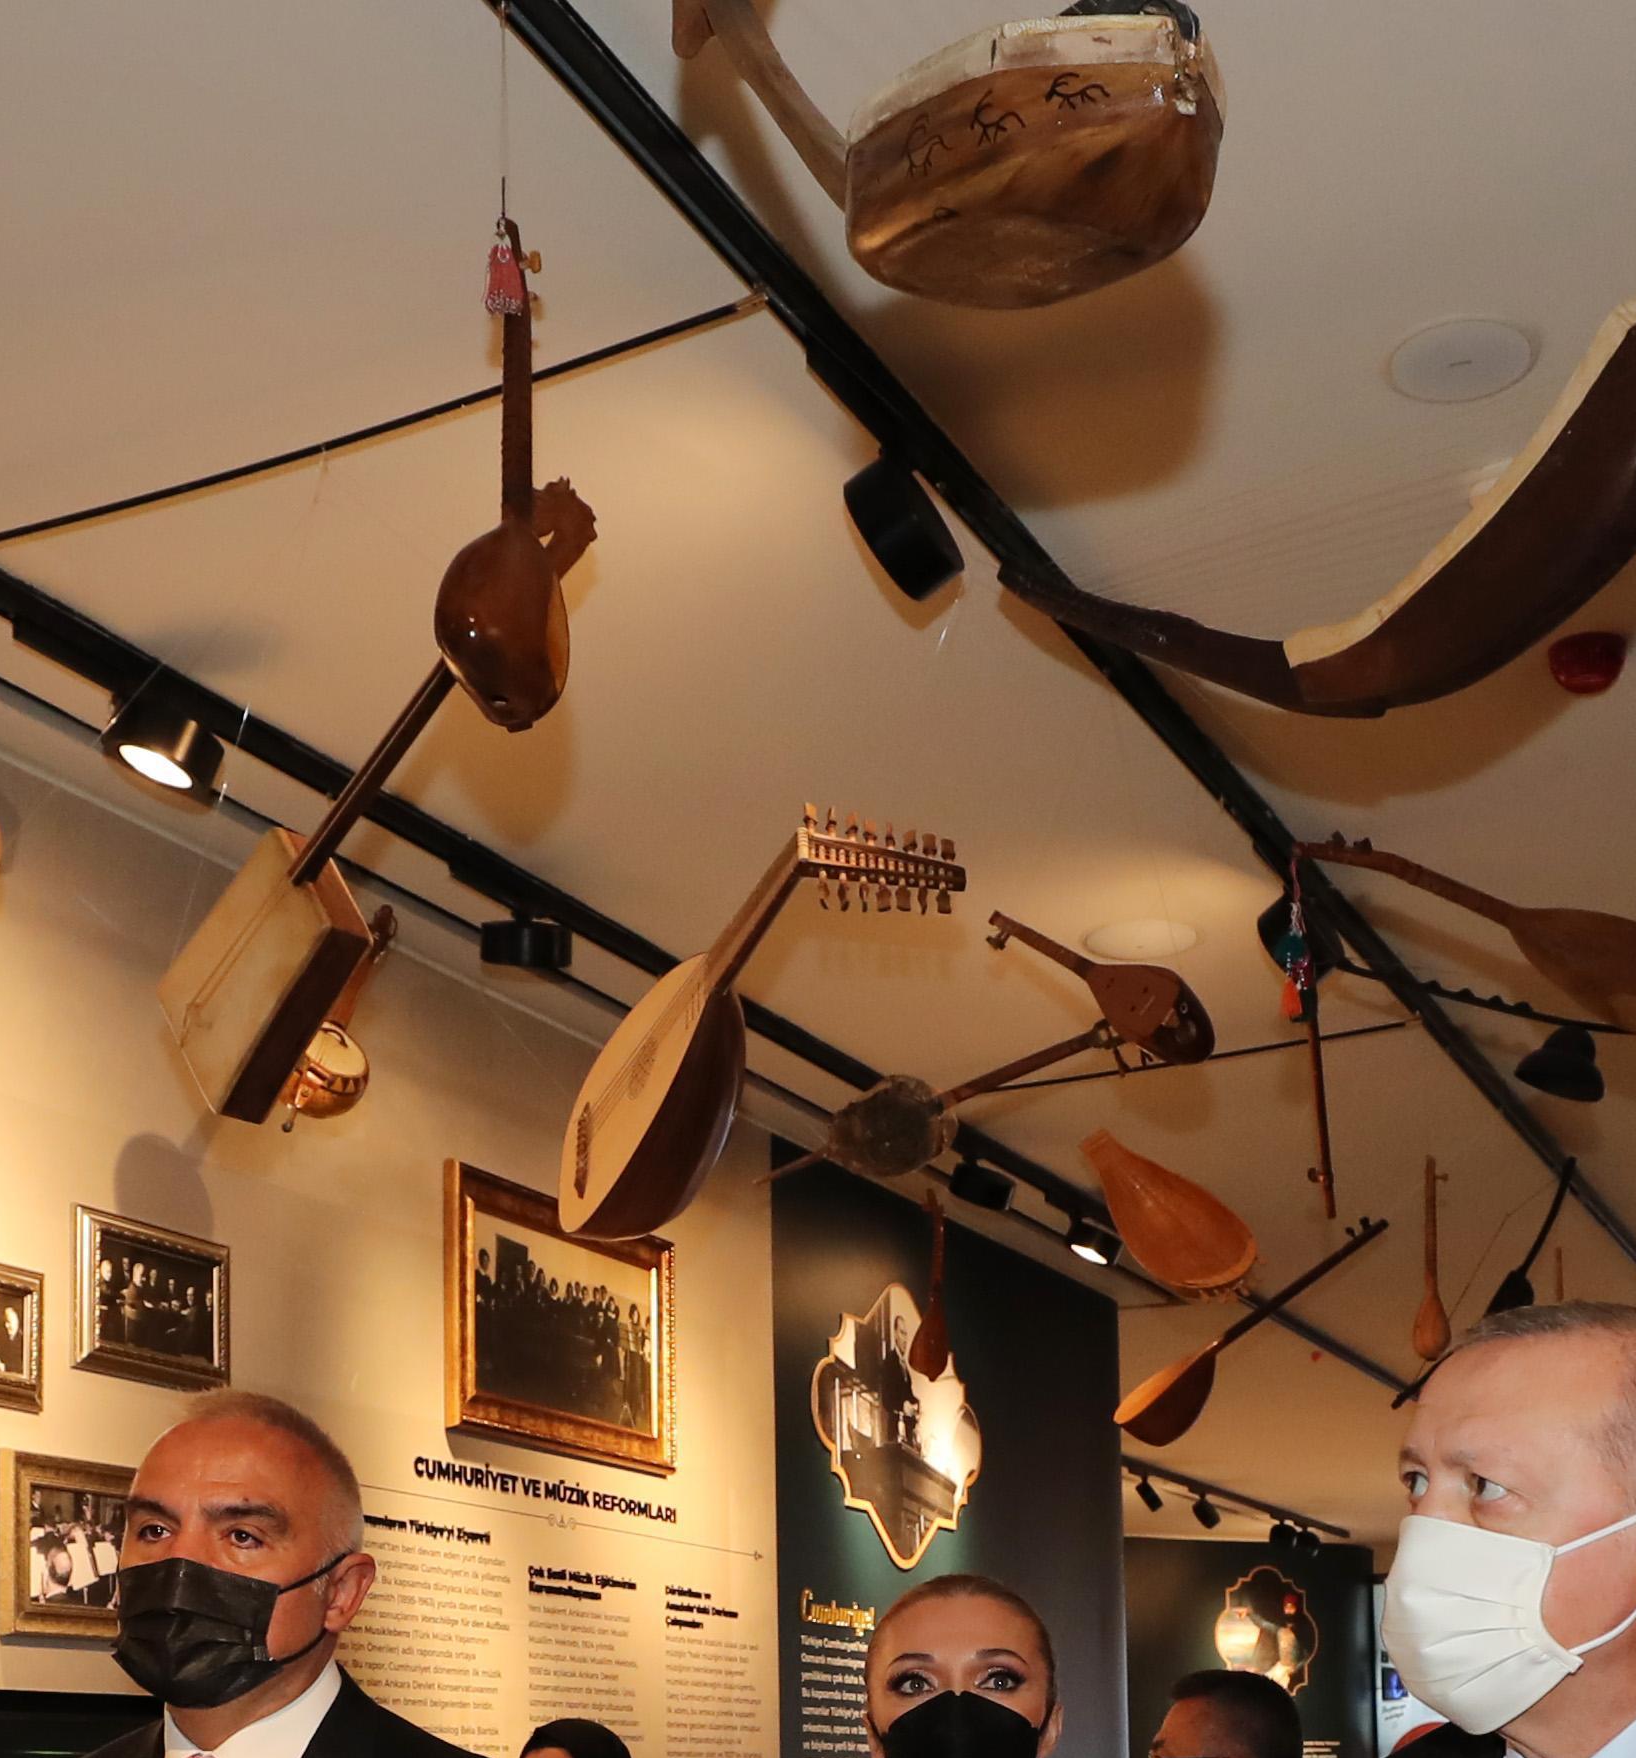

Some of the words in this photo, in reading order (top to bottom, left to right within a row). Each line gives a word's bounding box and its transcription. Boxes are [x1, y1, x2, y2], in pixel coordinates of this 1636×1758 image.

[413, 1456, 519, 1494] CUMHURİYET
[521, 1477, 542, 1498] VE
[544, 1479, 590, 1508] MÜZİK
[592, 1491, 677, 1524] REFORMLARI
